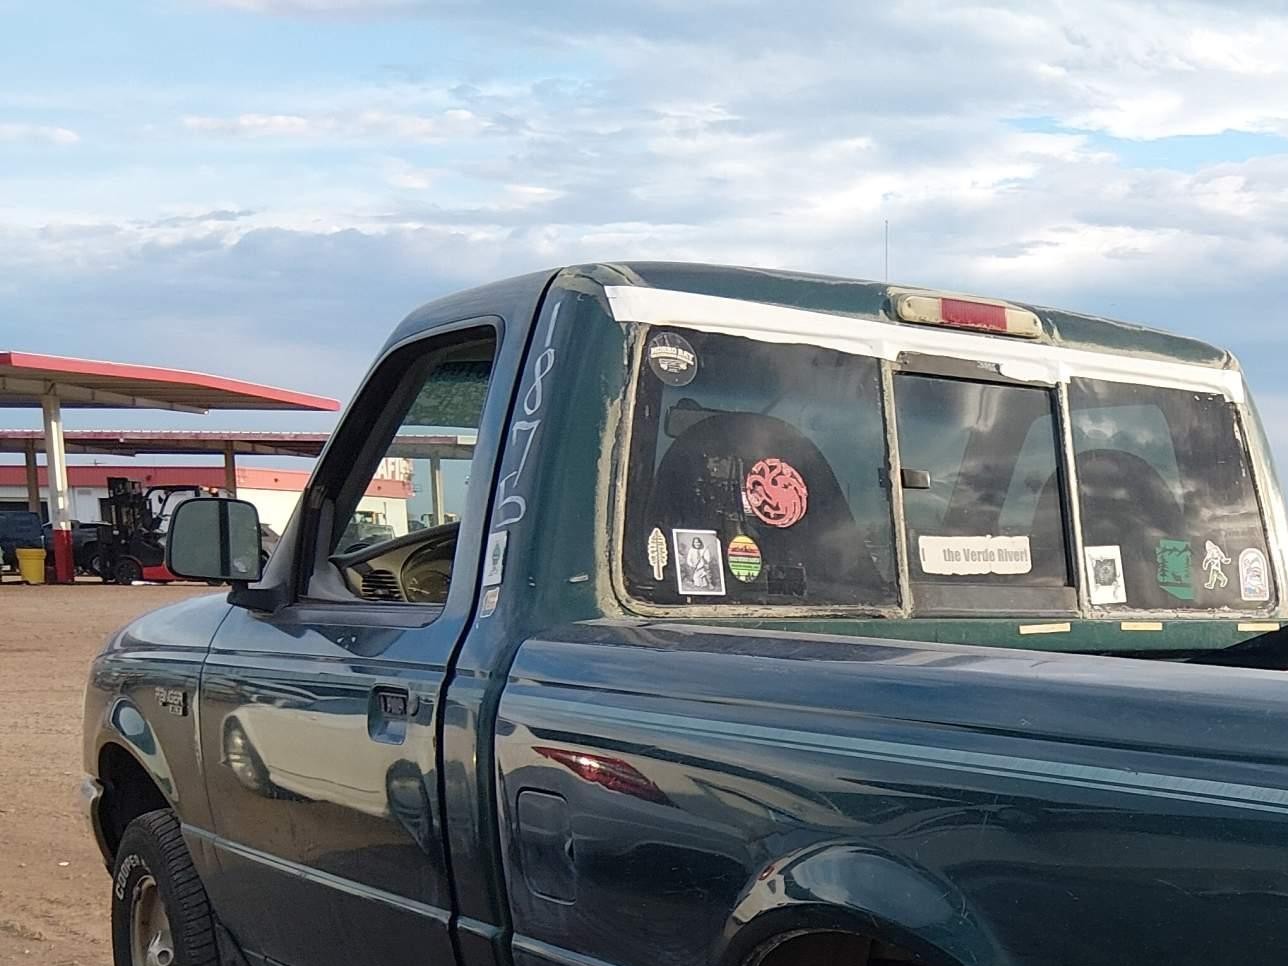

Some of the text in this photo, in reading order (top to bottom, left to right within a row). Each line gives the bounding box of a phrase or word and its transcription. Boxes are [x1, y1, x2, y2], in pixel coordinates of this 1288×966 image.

[495, 301, 561, 528] 1875
[943, 548, 961, 562] the
[963, 548, 995, 562] Verde
[115, 853, 140, 901] COOPER
